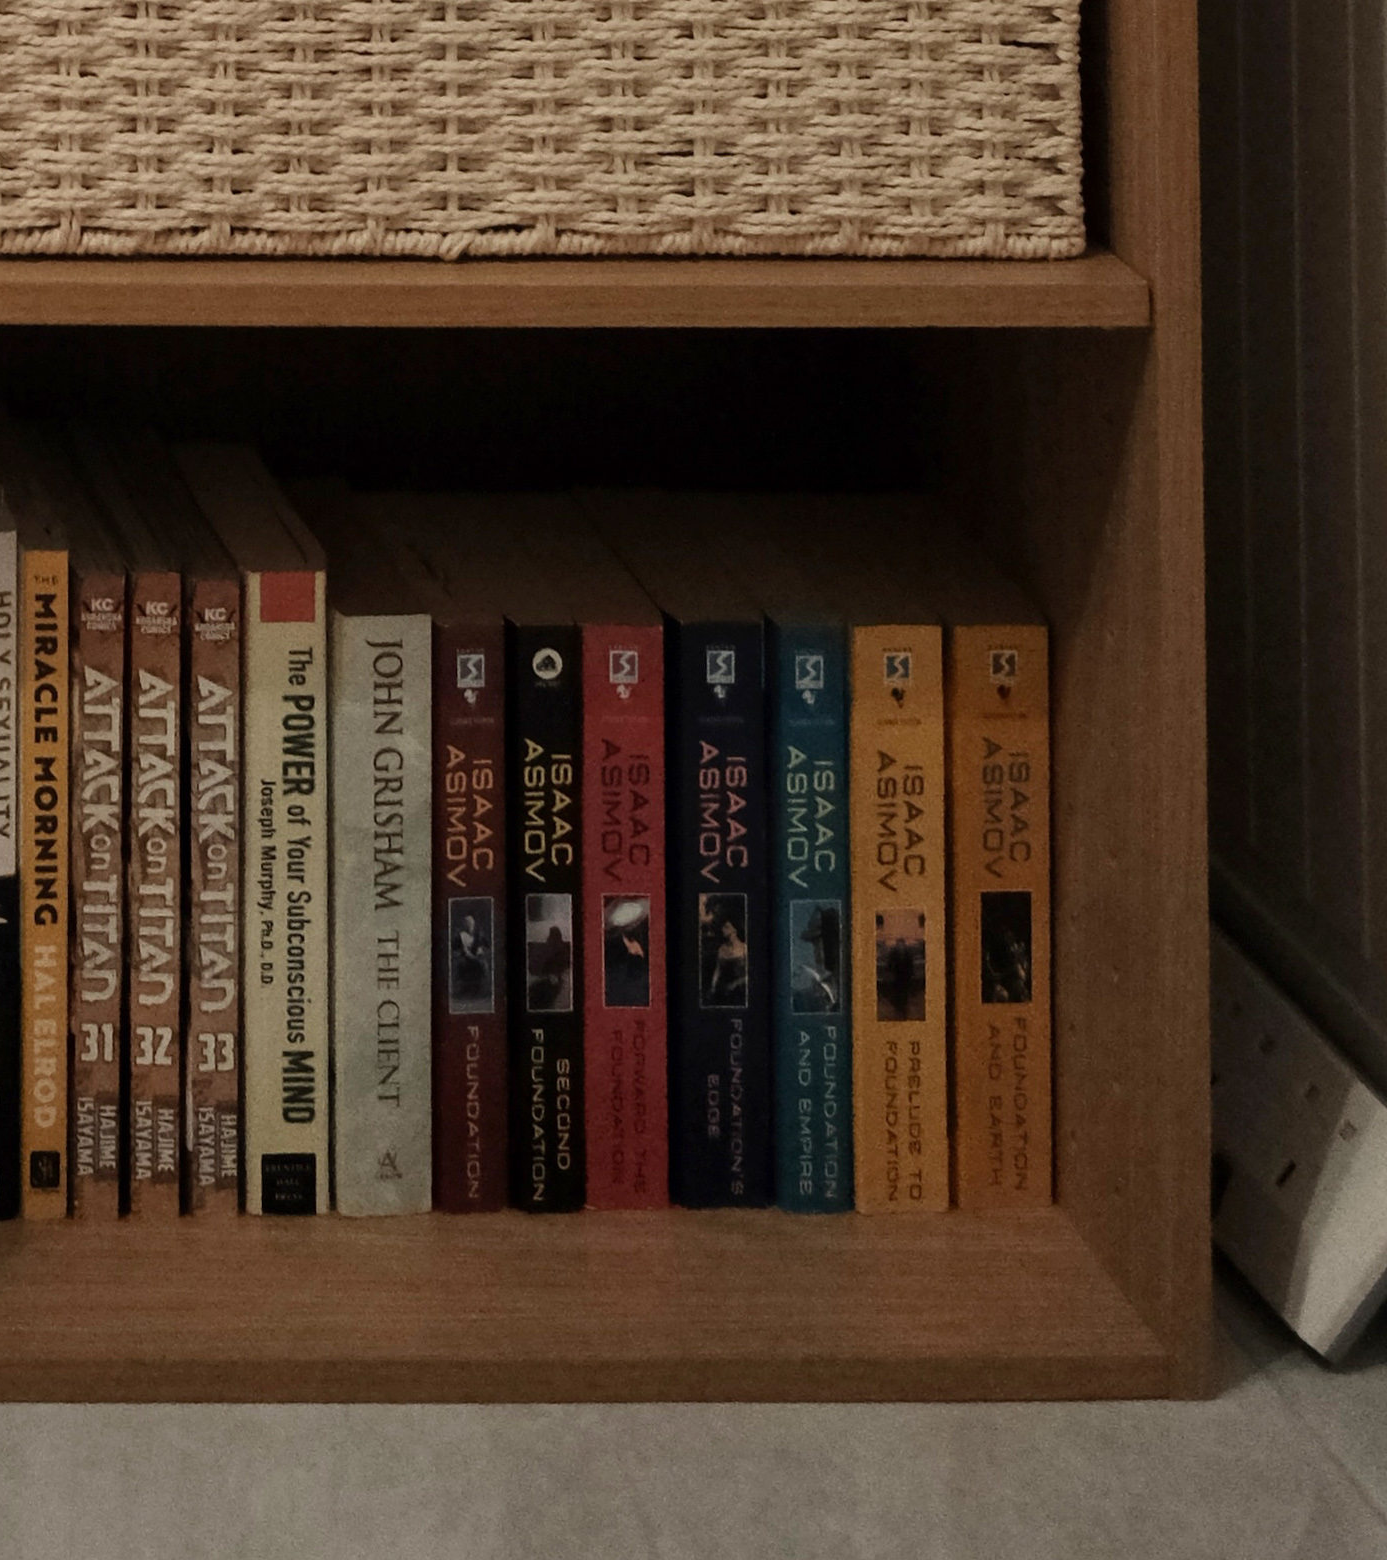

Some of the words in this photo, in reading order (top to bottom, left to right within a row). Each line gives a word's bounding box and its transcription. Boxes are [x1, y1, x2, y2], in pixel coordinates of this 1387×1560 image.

[34, 593, 58, 743] MIRACLE
[288, 647, 313, 687] The
[365, 639, 404, 736] JOHN
[82, 665, 121, 834] ATTACK
[138, 669, 175, 837] ATTACK
[197, 675, 235, 843] ATTACK
[282, 695, 316, 796] POWER
[34, 757, 58, 926] MORNING
[90, 834, 111, 871] on
[146, 837, 168, 874] on
[206, 843, 228, 880] on
[287, 805, 312, 827] of
[287, 835, 312, 885] Your
[373, 746, 404, 911] GRISHAM
[524, 738, 547, 883] ASIMOV
[551, 753, 573, 867] ISAAC
[698, 740, 721, 884] ASIMOV
[725, 756, 749, 869] ISAAC
[33, 945, 57, 1009] HAL
[81, 875, 118, 1002] TITAN
[138, 878, 175, 1007] TITAN
[200, 883, 235, 1012] TITAN
[287, 890, 312, 1044] Subconscious
[377, 930, 400, 991] THE
[33, 1020, 57, 1128] ELROD
[80, 1023, 114, 1062] 31
[135, 1027, 173, 1065] 32
[198, 1033, 235, 1072] 33
[282, 1051, 316, 1124] MIND
[377, 999, 401, 1108] CLIENT
[530, 1028, 545, 1202] FOUNDATION
[556, 1058, 570, 1170] SECOND
